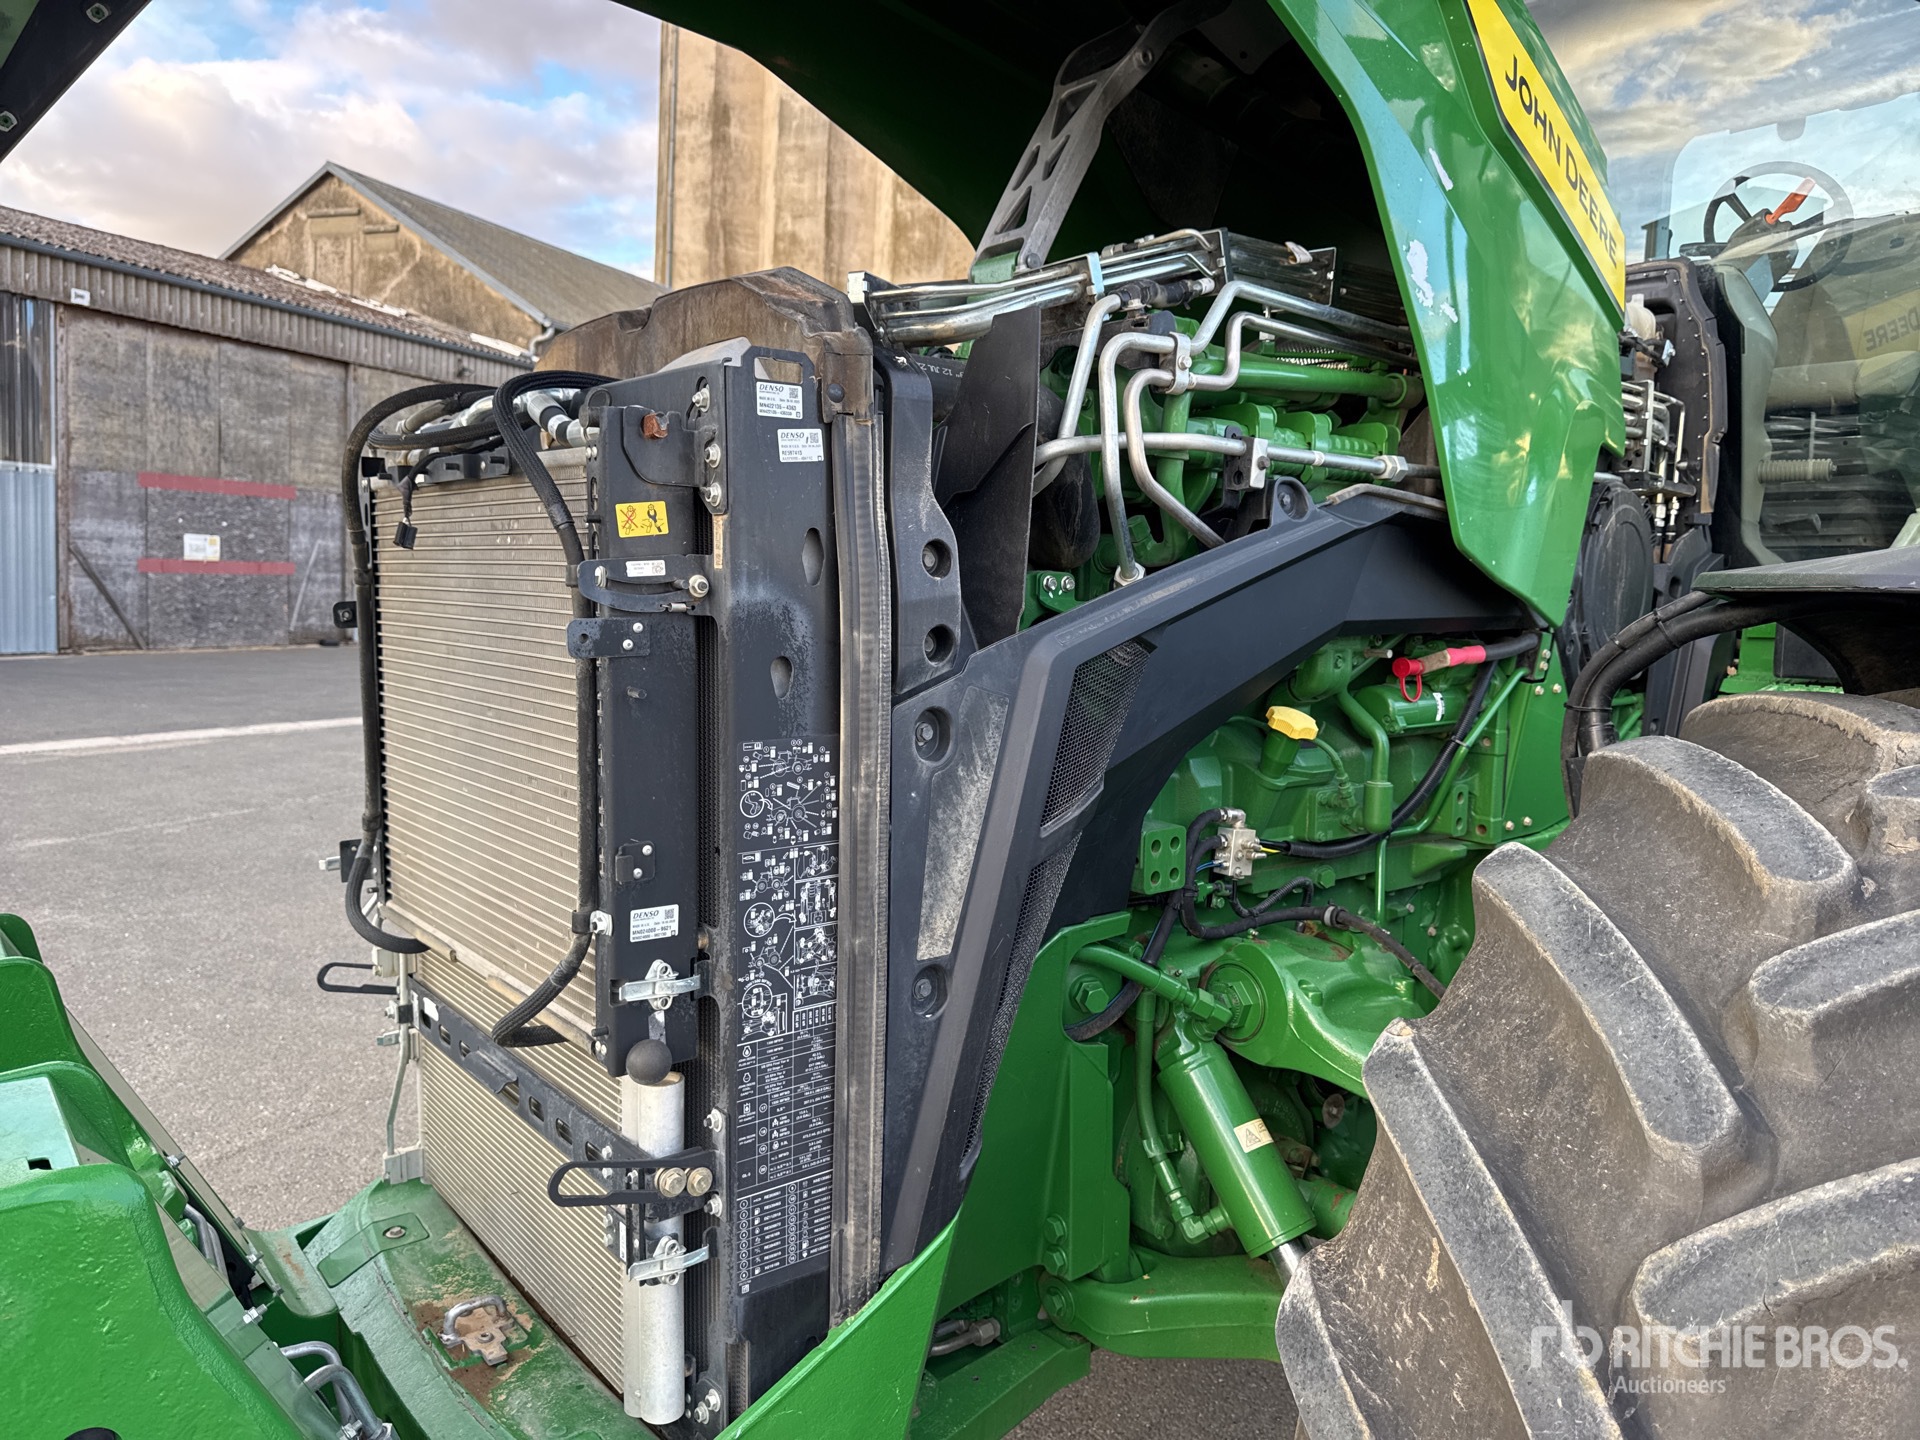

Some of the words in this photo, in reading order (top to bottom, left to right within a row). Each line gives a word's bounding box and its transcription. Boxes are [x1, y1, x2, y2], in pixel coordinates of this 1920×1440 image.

[1505, 54, 1561, 167] JOHN
[1565, 143, 1617, 269] DEERE
[760, 384, 784, 392] DENSO
[633, 910, 660, 919] DENSO
